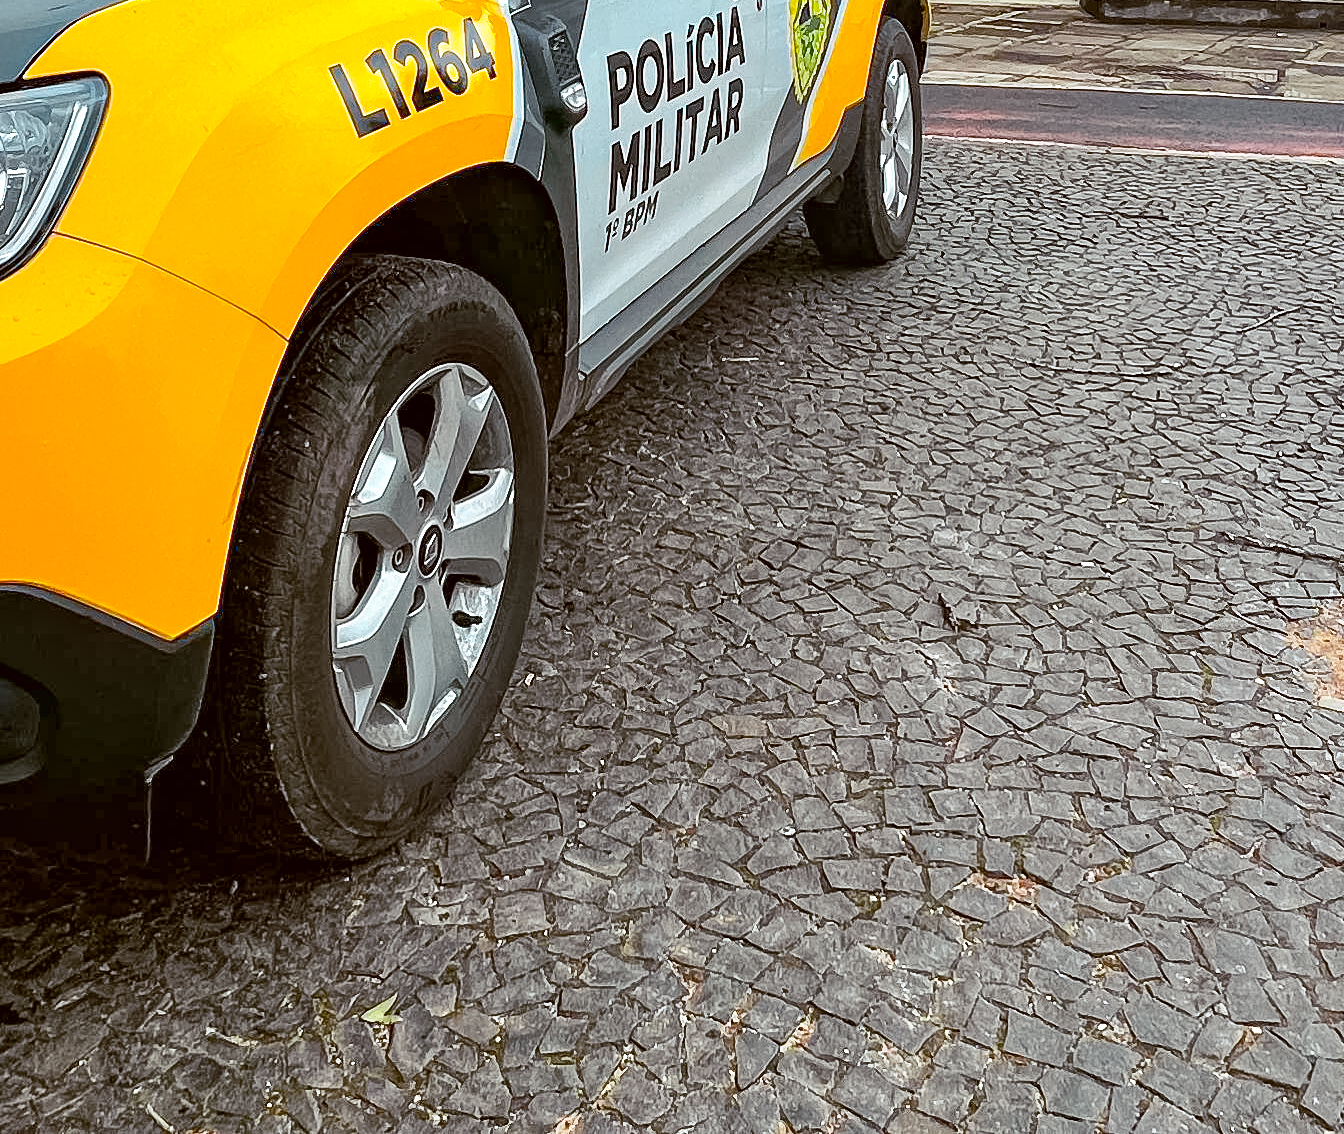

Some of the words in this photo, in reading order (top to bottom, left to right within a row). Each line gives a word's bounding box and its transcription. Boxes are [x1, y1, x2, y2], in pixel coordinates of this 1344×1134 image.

[328, 17, 498, 139] L1264
[606, 6, 746, 131] POLÍCIA
[608, 77, 744, 216] MILITAR
[621, 190, 660, 242] BPM
